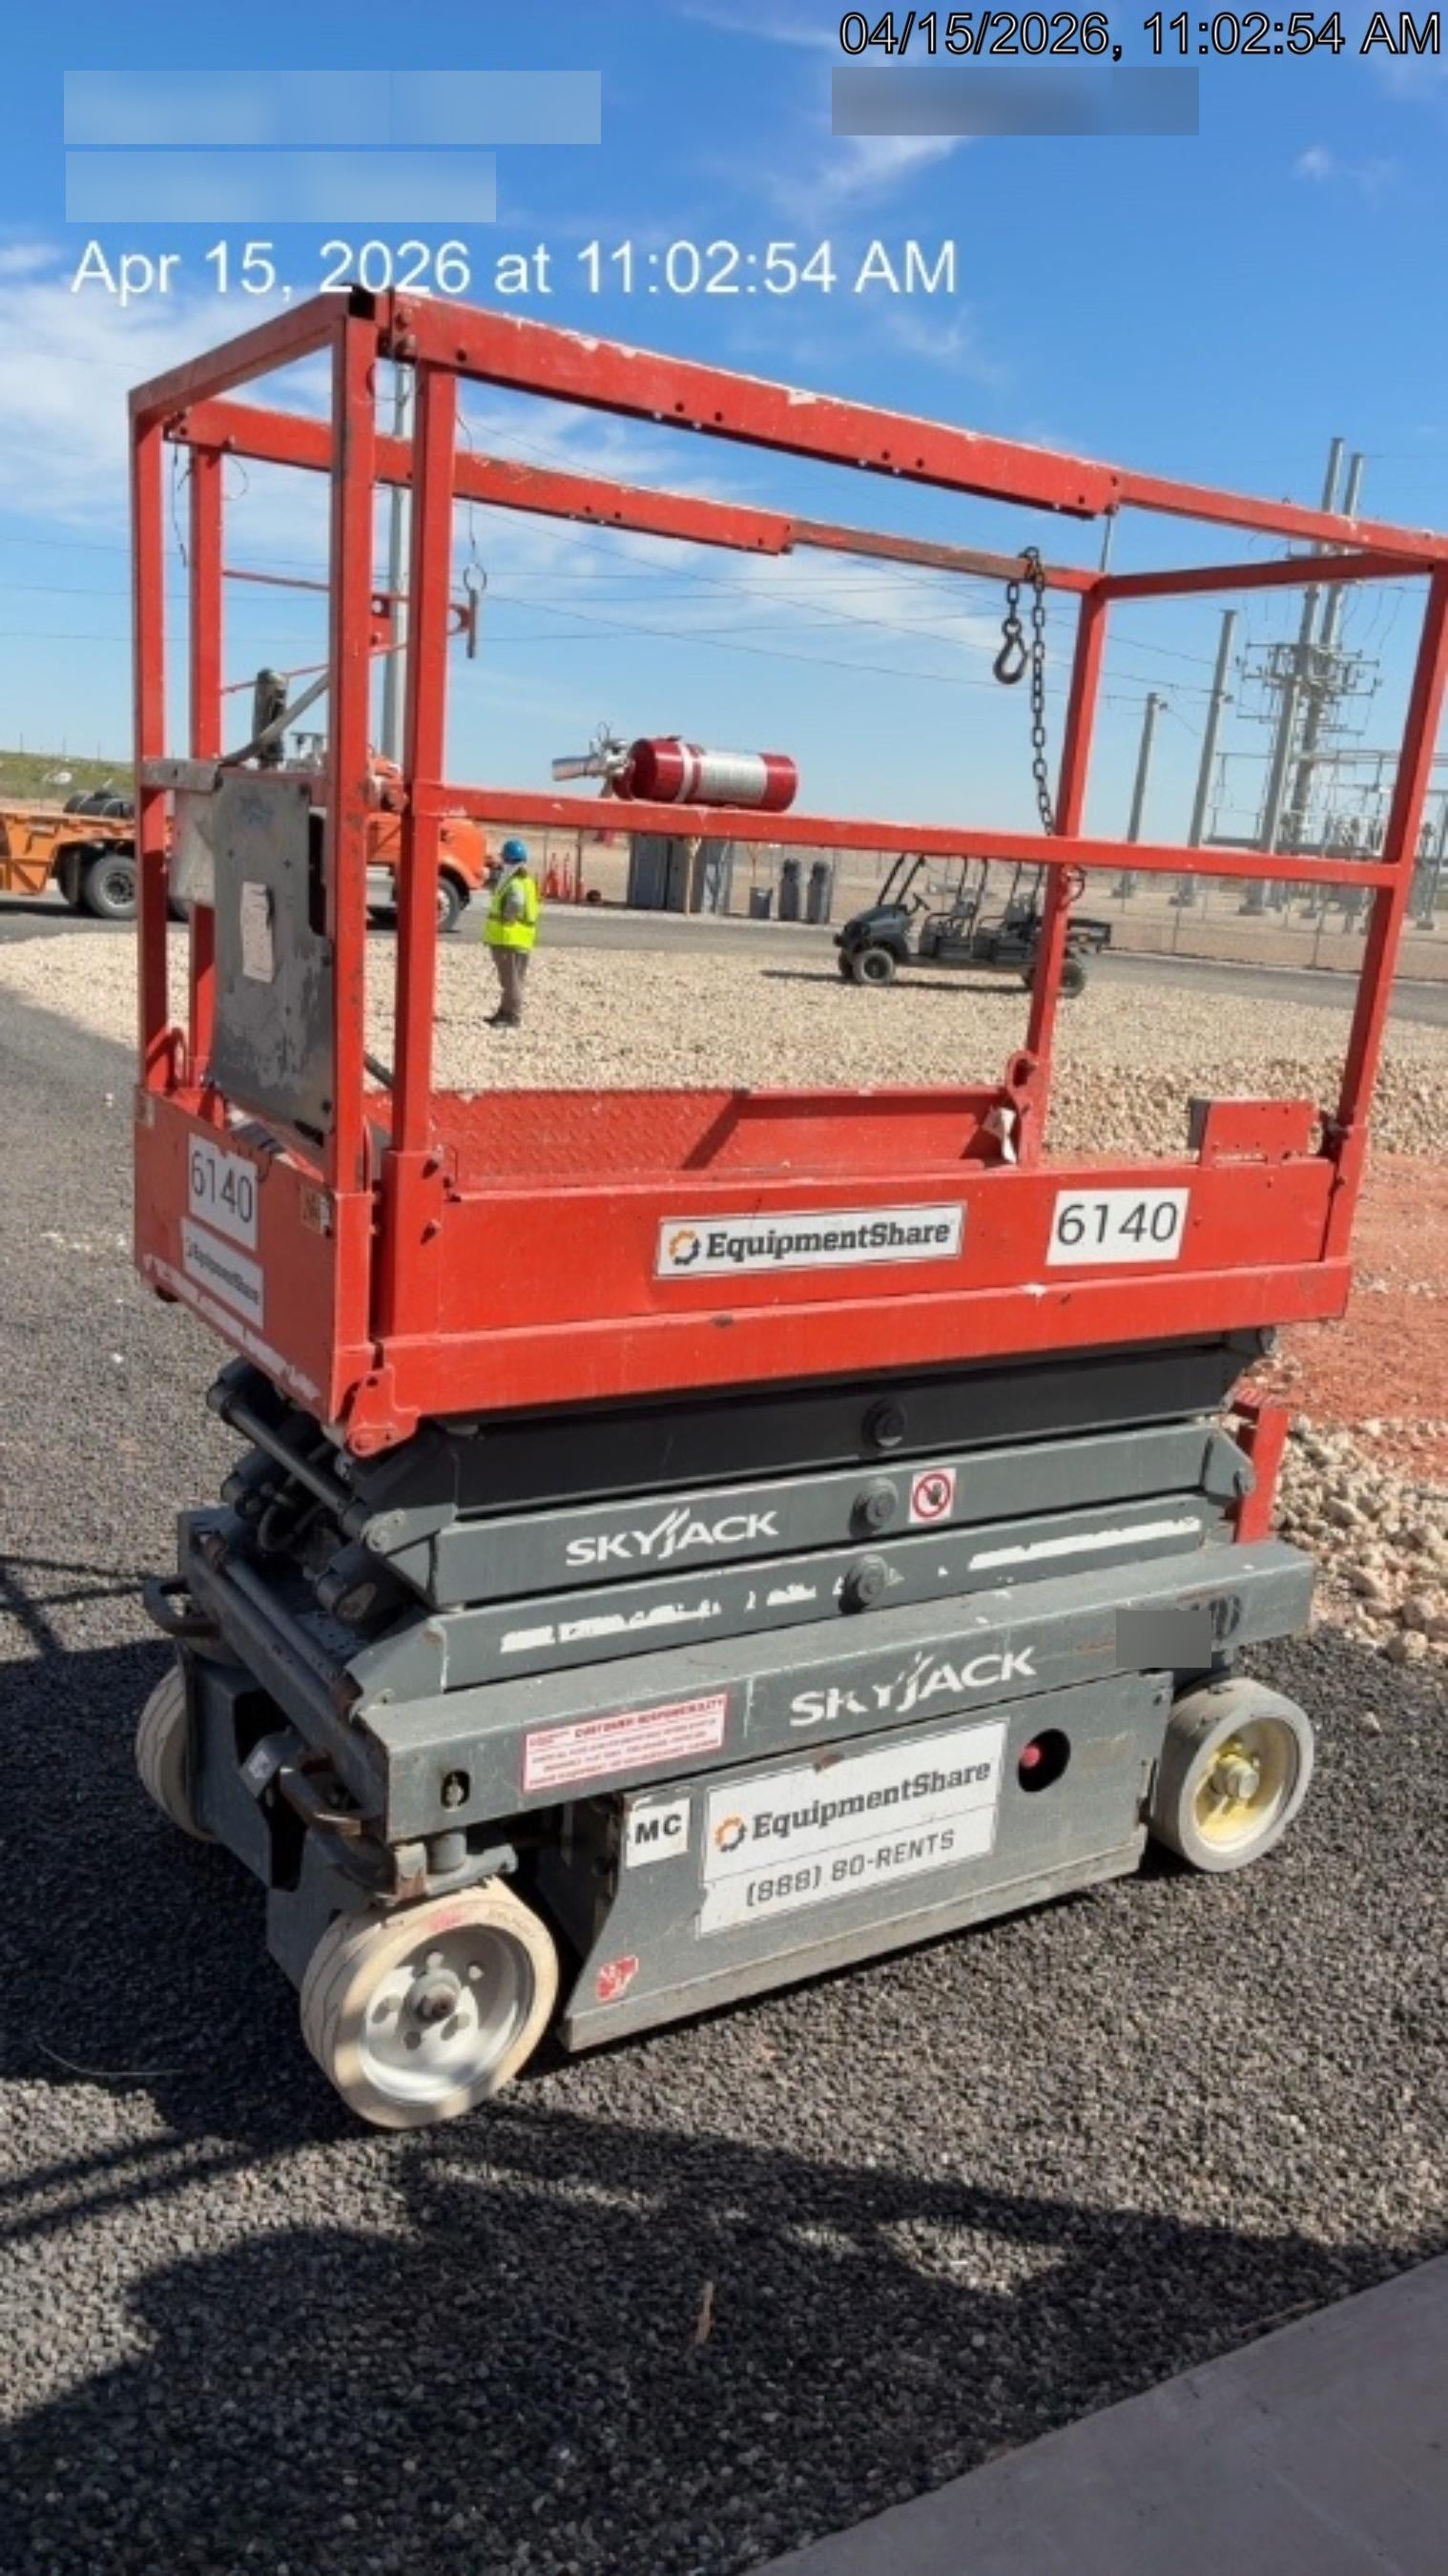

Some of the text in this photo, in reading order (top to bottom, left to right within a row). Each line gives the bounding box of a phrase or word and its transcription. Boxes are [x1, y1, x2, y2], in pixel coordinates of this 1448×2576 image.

[191, 1150, 252, 1223] 6140
[707, 1221, 950, 1261] EquipmentShare
[1057, 1202, 1177, 1245] 6140
[565, 1507, 779, 1567] SKYJACK
[789, 1646, 1037, 1727] SKYJACK
[635, 1815, 682, 1845] MC
[752, 1760, 991, 1841] EquipmentShare
[746, 1828, 956, 1907] (888) 80-RENTS
